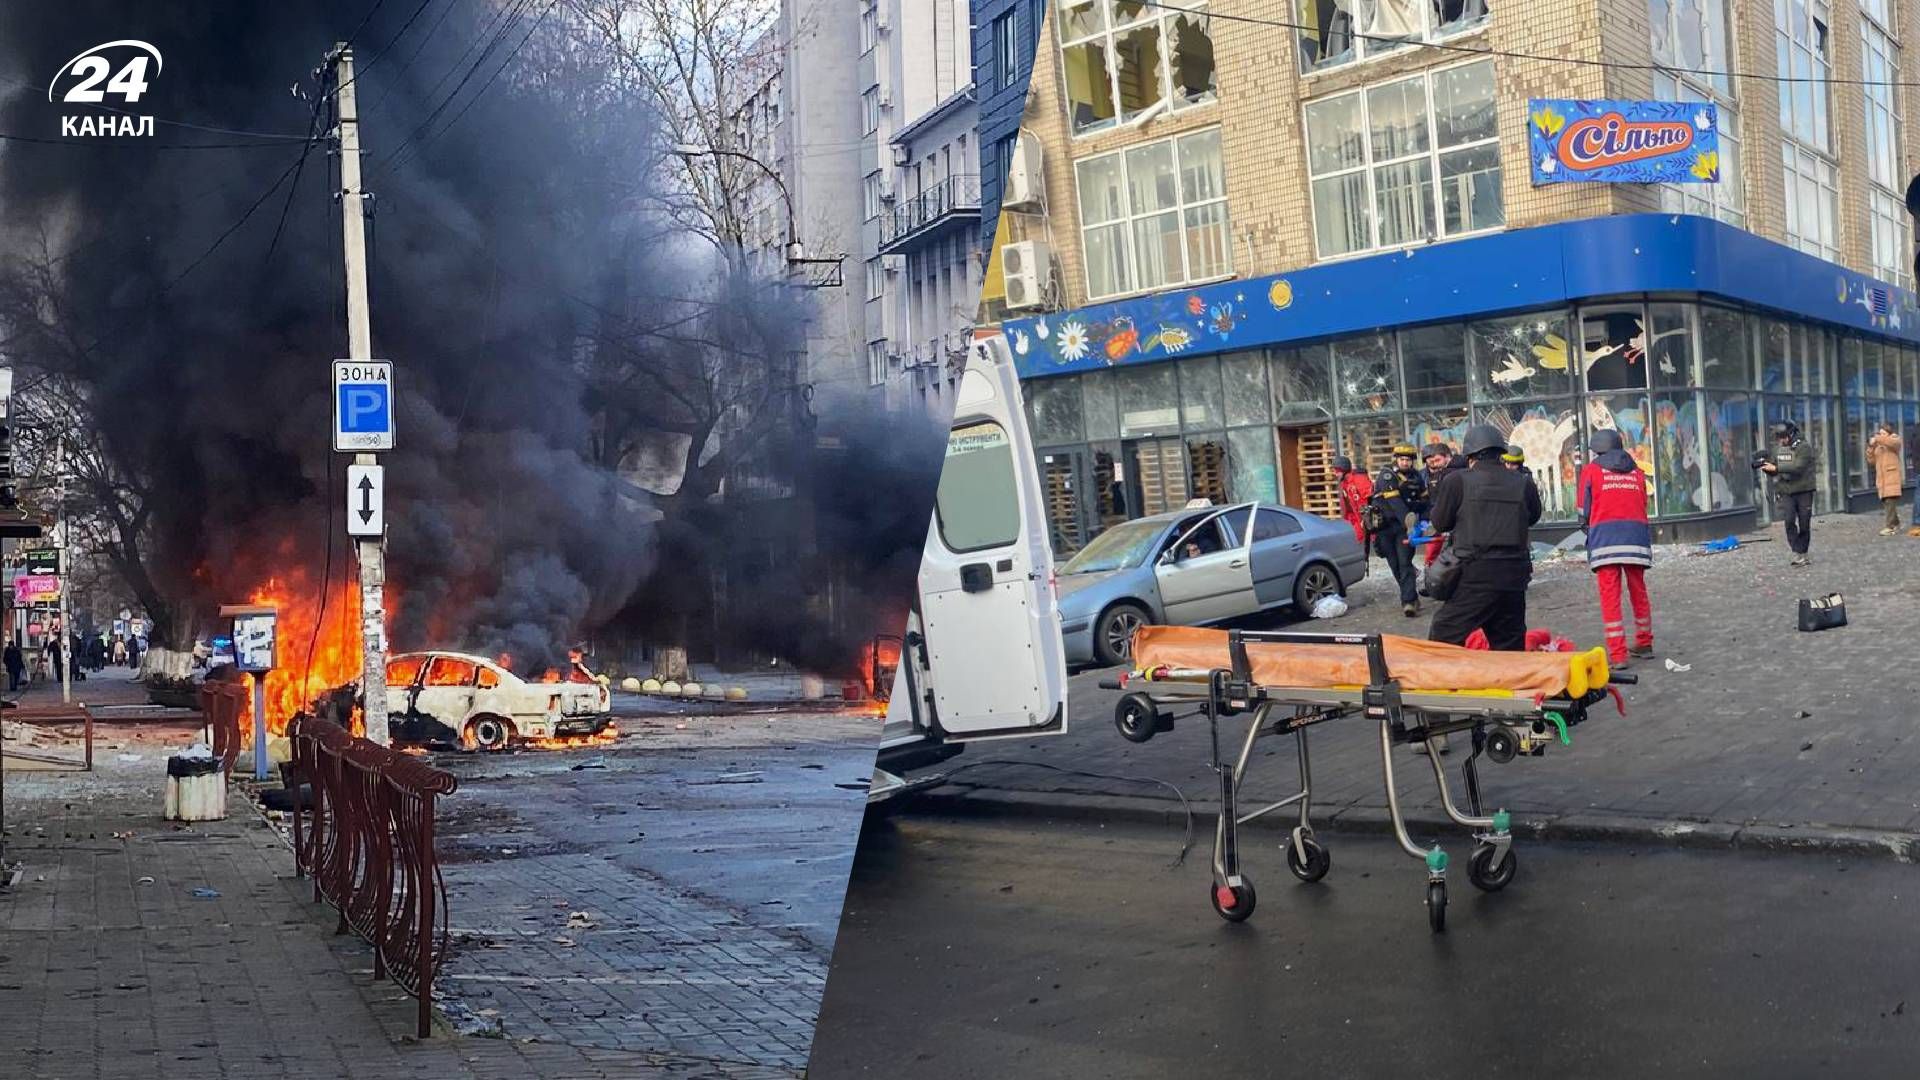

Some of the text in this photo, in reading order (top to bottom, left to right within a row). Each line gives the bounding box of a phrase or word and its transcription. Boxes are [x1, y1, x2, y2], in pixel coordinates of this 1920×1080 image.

[1570, 120, 1688, 162] Сільпо
[341, 367, 387, 381] ЗОНА
[347, 389, 382, 428] P
